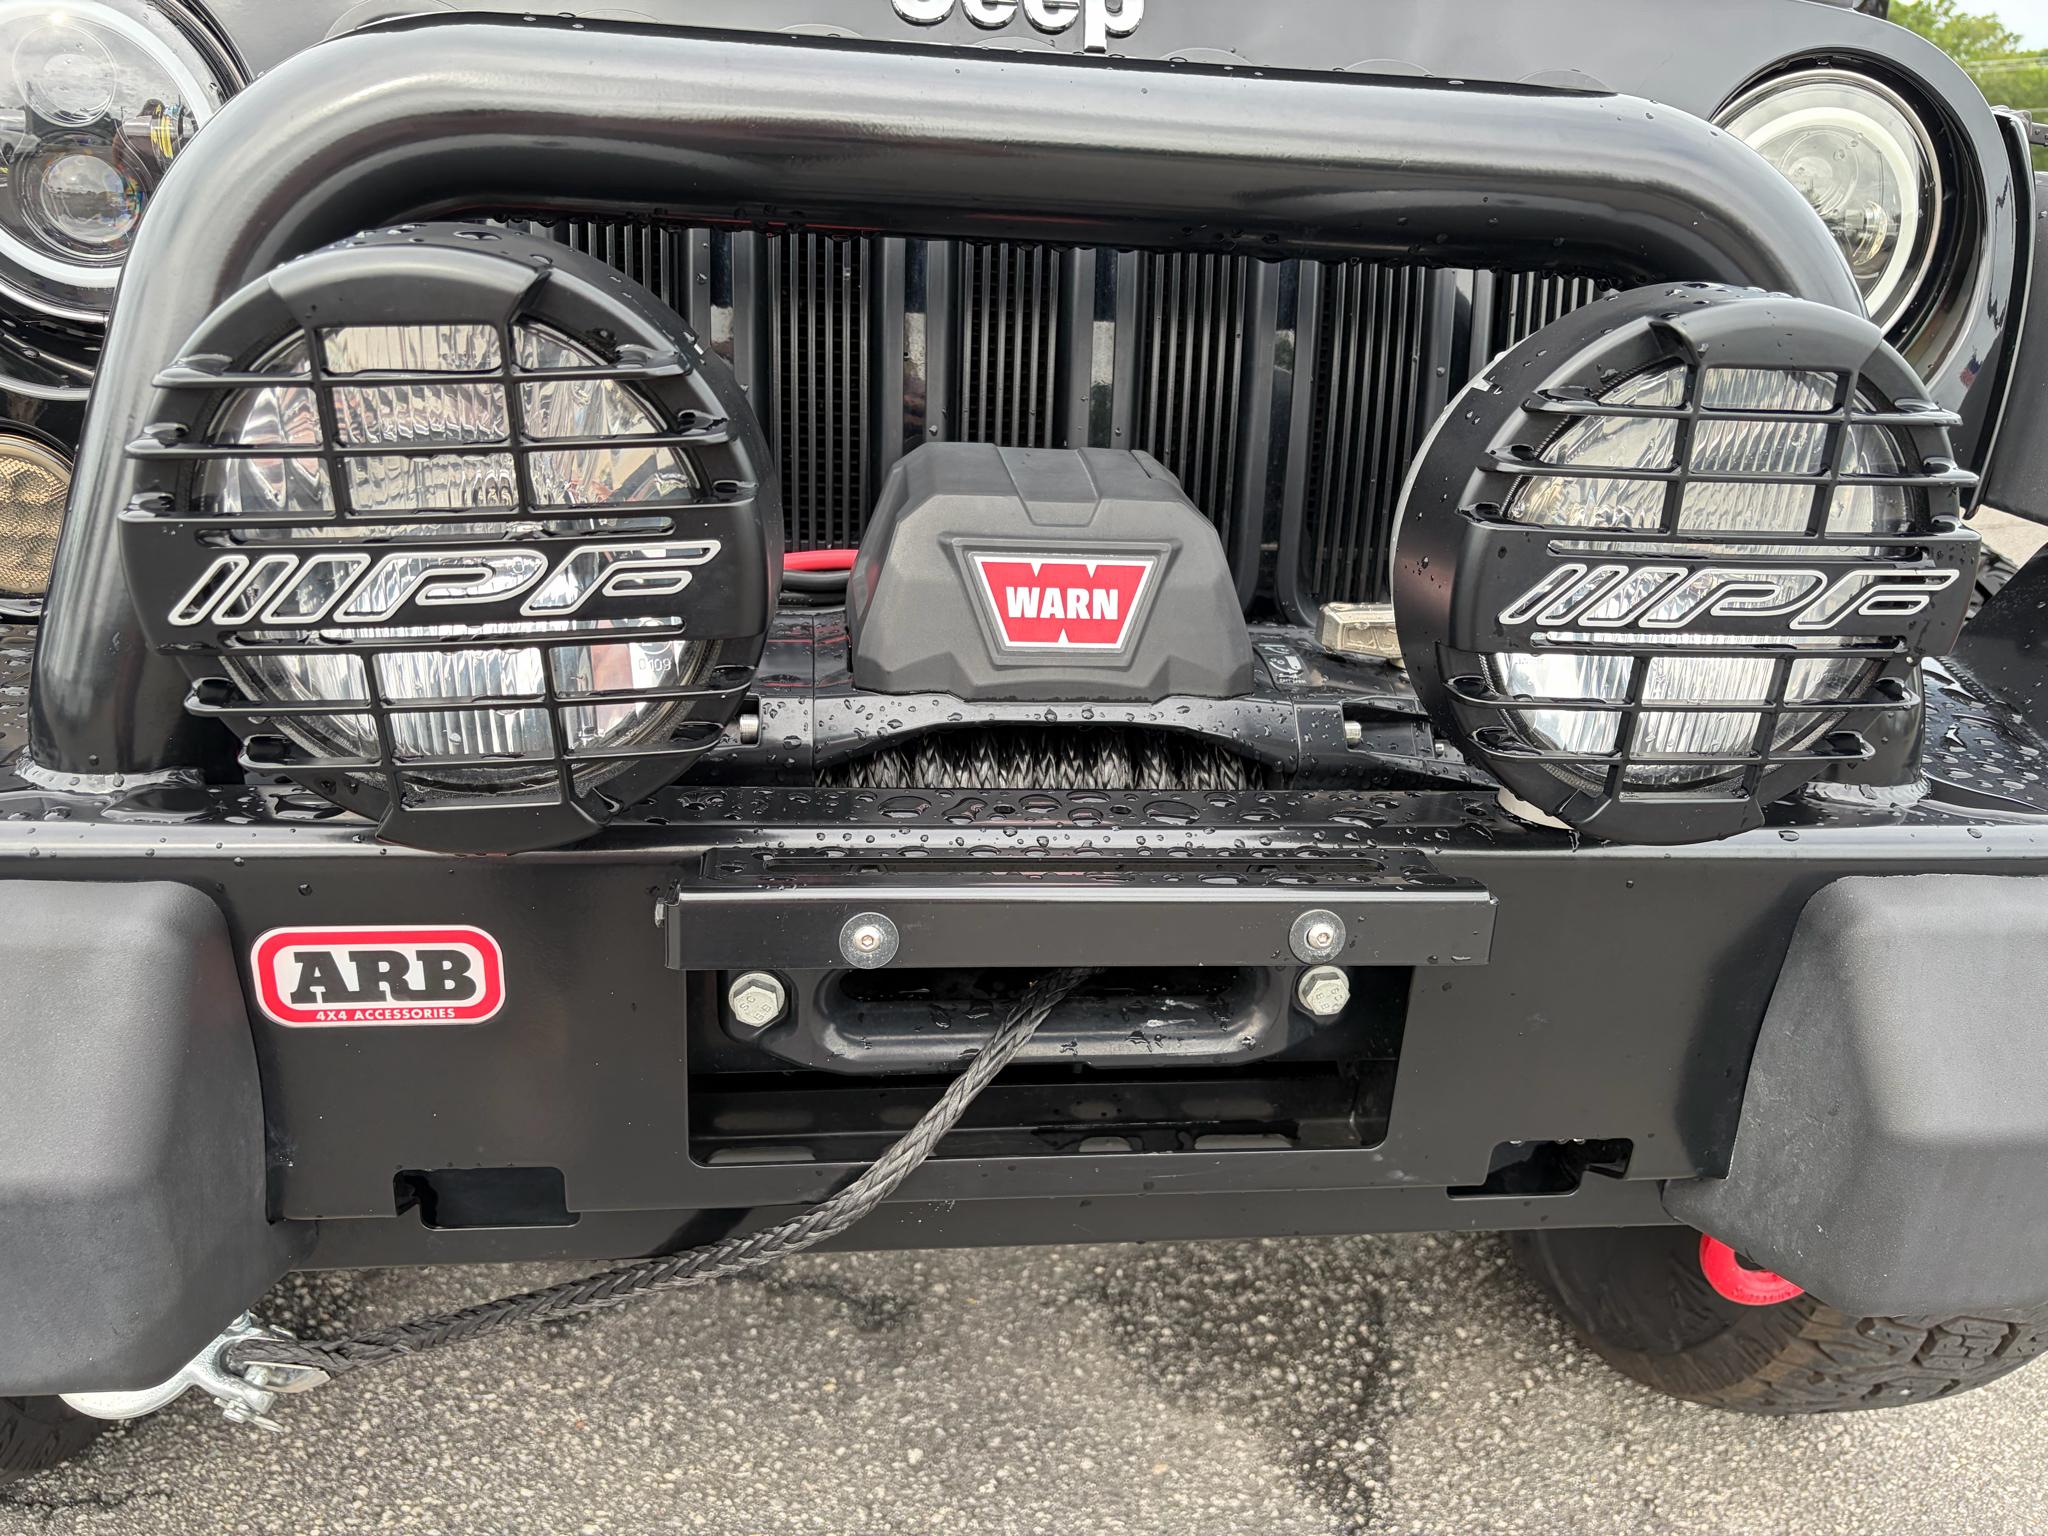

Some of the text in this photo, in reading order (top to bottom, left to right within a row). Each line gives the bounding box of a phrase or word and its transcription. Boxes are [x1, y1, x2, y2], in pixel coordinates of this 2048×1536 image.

[890, 0, 1145, 52] eep
[1005, 586, 1119, 620] WARN
[289, 949, 477, 1004] ARB
[315, 1007, 457, 1021] 4X4 ACCESSORIES
